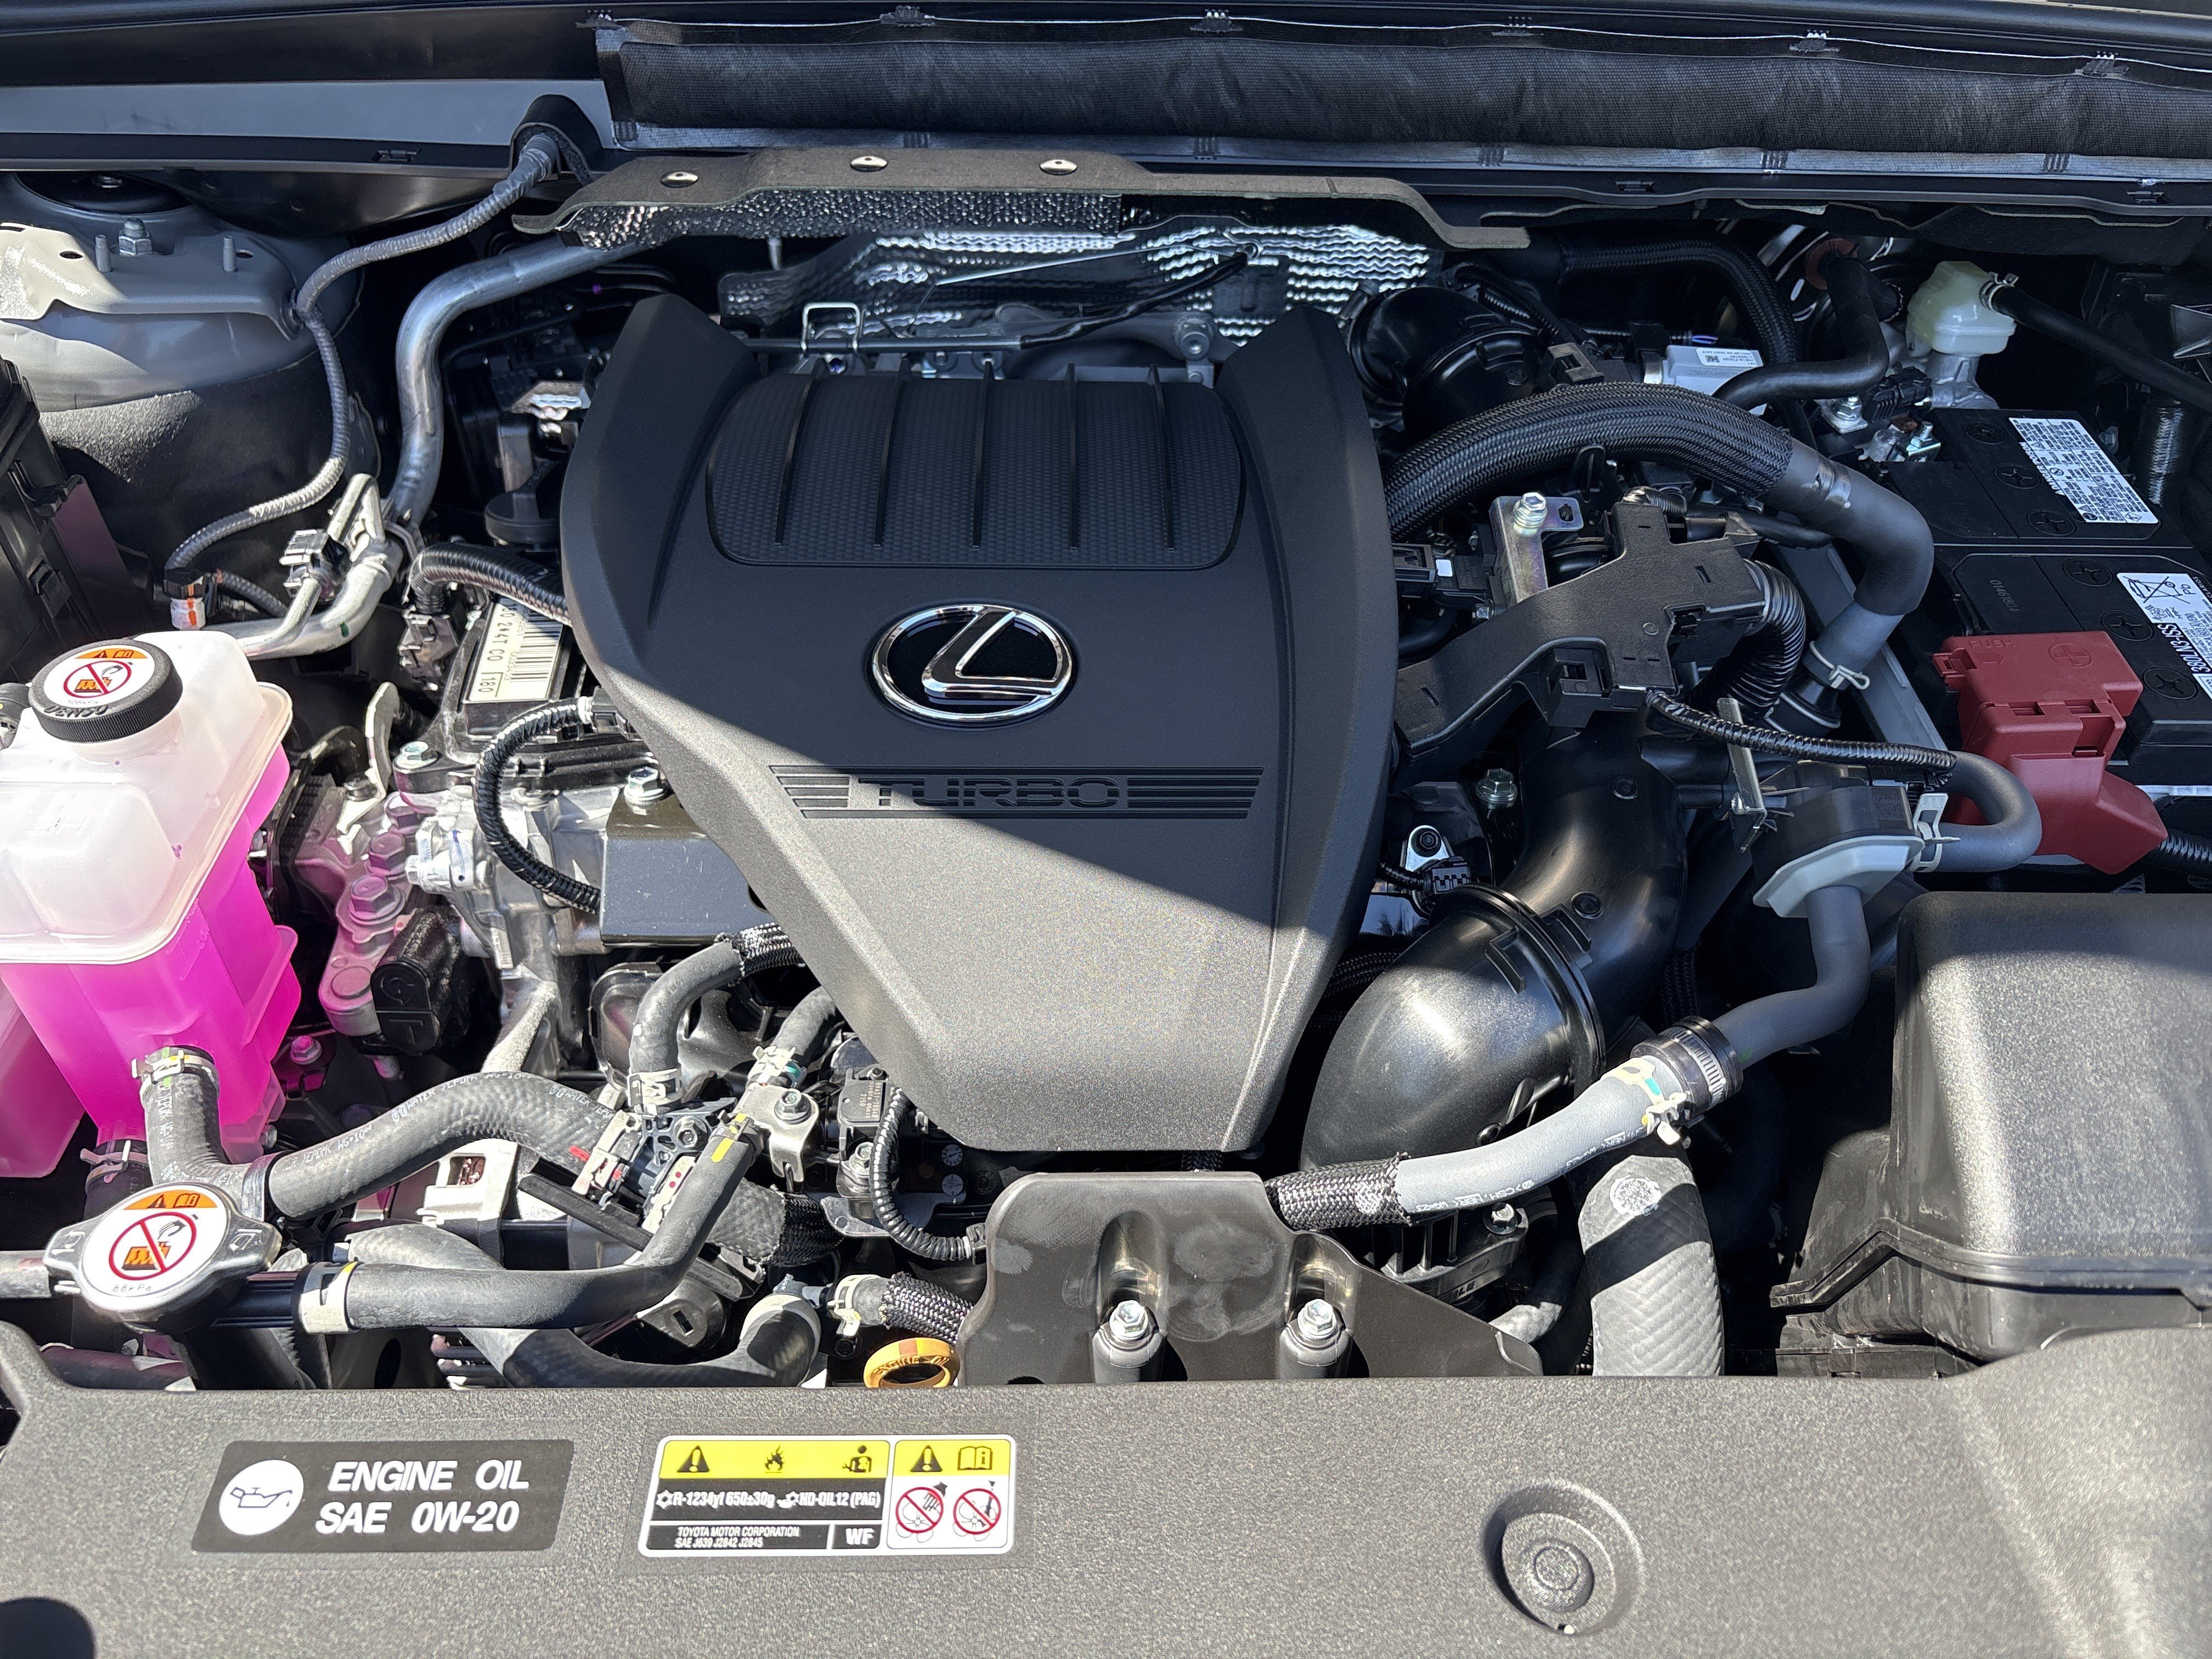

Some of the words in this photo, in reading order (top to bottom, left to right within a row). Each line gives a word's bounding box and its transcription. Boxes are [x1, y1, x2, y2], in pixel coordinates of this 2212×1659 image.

[2180, 584, 2196, 594] Pb
[1968, 640, 2015, 650] PUSH
[2157, 624, 2211, 673] 380LN3-ISS
[478, 677, 496, 693] 180
[43, 705, 109, 718] DENSO
[859, 777, 1120, 807] TURBO
[407, 1088, 436, 1110] WATER
[112, 1284, 151, 1292] 88kPa
[873, 1355, 920, 1375] ENGINE
[328, 1460, 457, 1491] ENGINE
[475, 1459, 529, 1490] OIL
[850, 1491, 881, 1509] (PAG)
[315, 1502, 392, 1534] SAE
[411, 1500, 520, 1533] 0W-20
[678, 1526, 710, 1537] TOYOTA
[710, 1526, 741, 1537] MOTOR
[741, 1526, 800, 1537] CORPORATION
[845, 1528, 874, 1545] WF
[674, 1537, 692, 1548] SAE
[692, 1537, 713, 1548] J639
[713, 1537, 738, 1548] J2842
[738, 1537, 764, 1548] J2845
